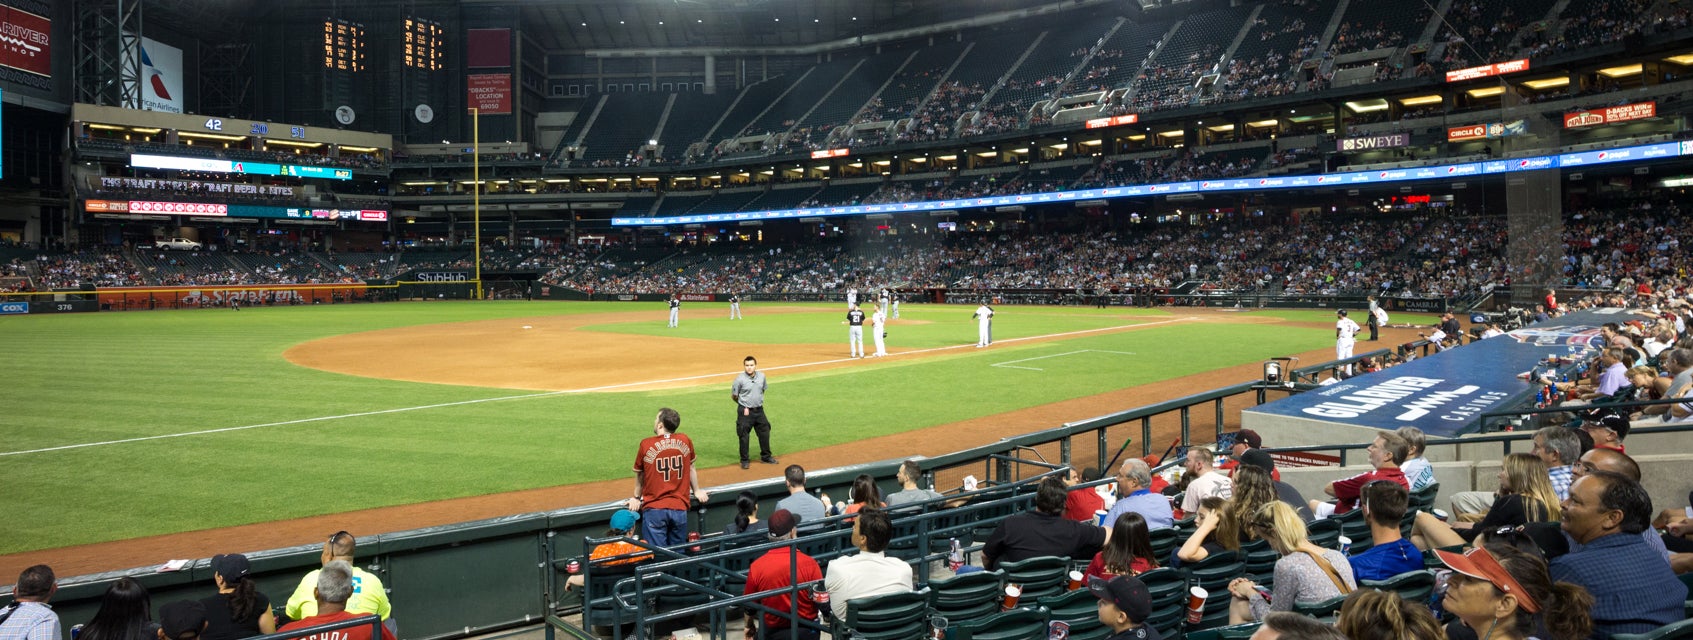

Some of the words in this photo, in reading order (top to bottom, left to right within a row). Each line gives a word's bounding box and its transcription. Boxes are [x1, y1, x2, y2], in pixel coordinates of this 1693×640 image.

[2, 22, 48, 45] RIVER
[4, 44, 34, 56] INOS
[157, 102, 180, 113] Airlines
[1606, 106, 1632, 114] D-BACKS
[205, 119, 222, 130] 42
[250, 123, 268, 134] 20
[291, 126, 304, 138] 51
[1609, 150, 1630, 159] pepsi
[234, 184, 257, 194] BEER
[418, 272, 466, 282] StubHub
[1406, 300, 1438, 310] CAMBRIA
[1440, 391, 1508, 420] CASINOS
[656, 455, 682, 482] 44
